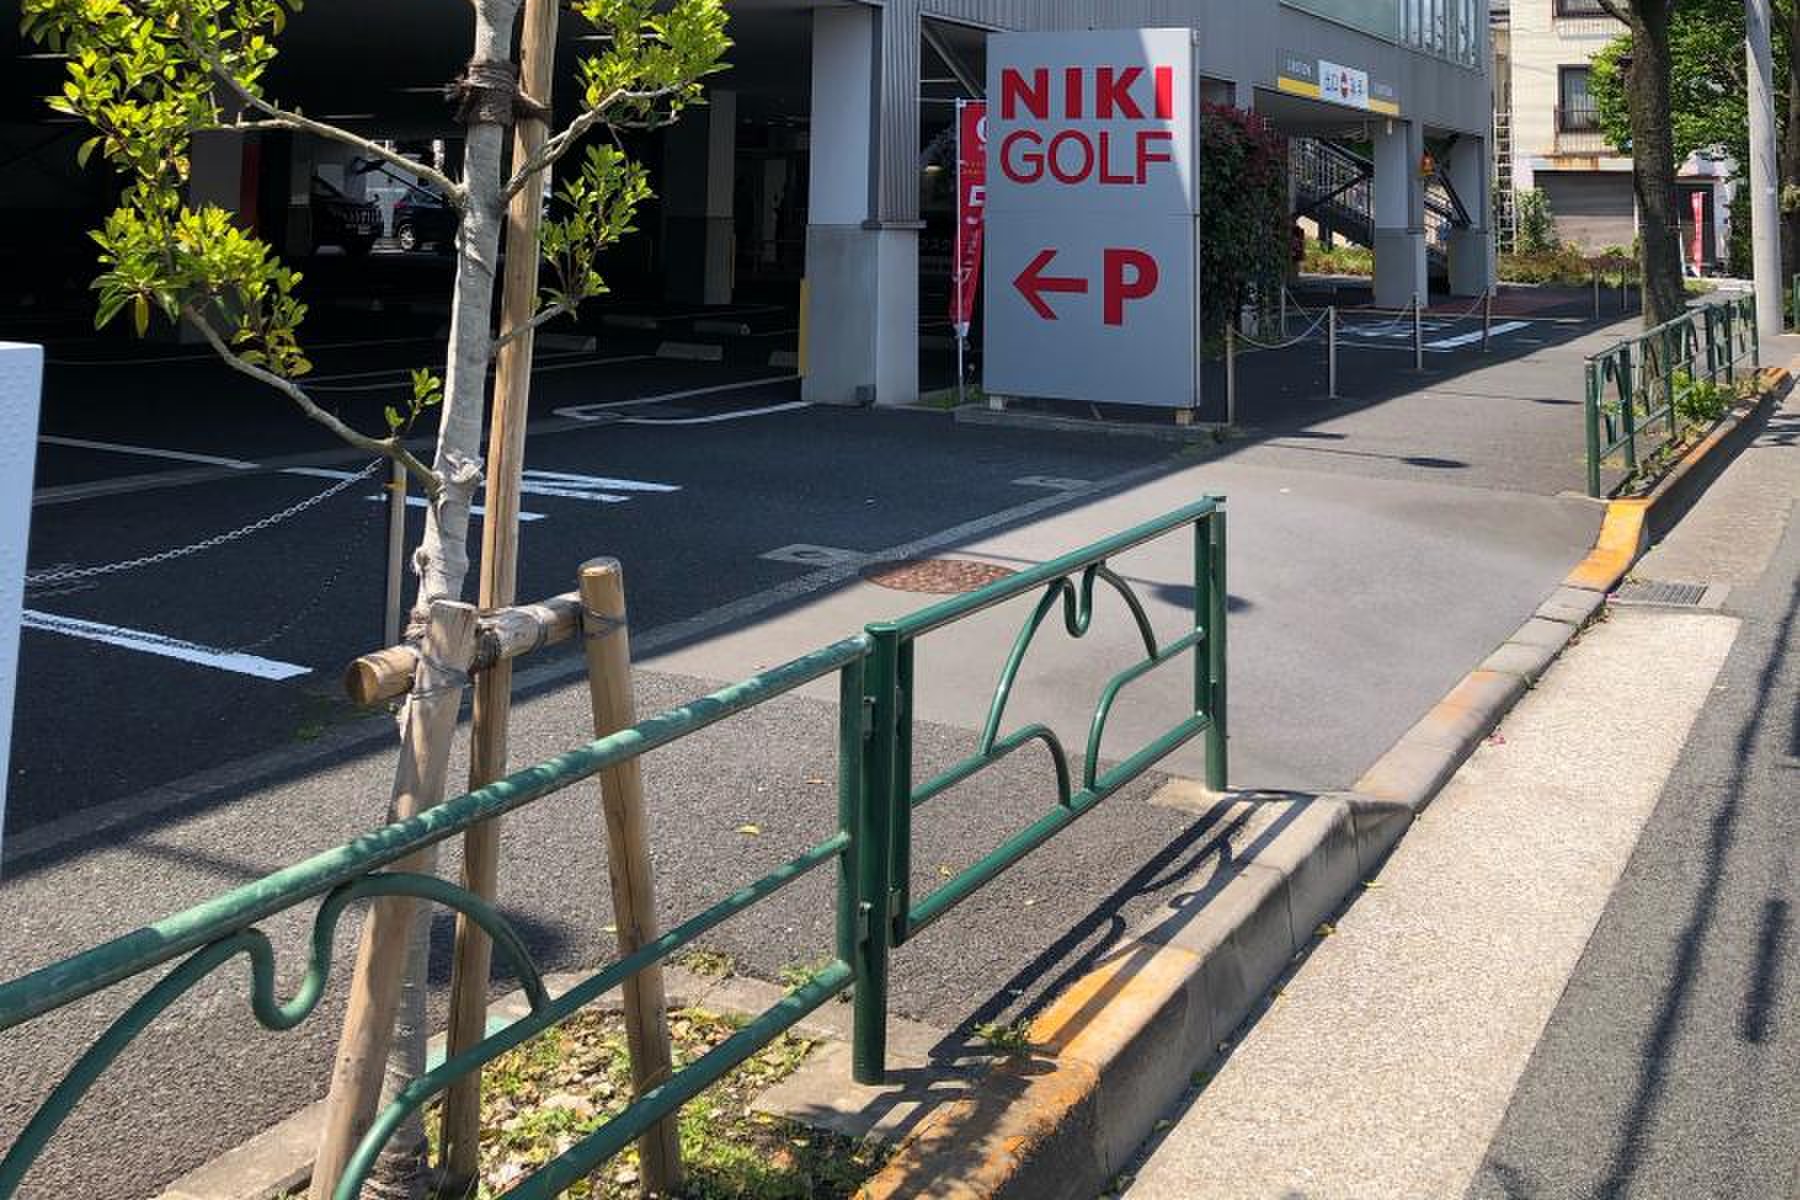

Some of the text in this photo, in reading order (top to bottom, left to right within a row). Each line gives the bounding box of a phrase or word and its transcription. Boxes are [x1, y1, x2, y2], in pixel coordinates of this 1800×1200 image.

[1001, 66, 1173, 120] NIKI
[1000, 129, 1173, 184] GOLF
[1103, 248, 1159, 326] P
